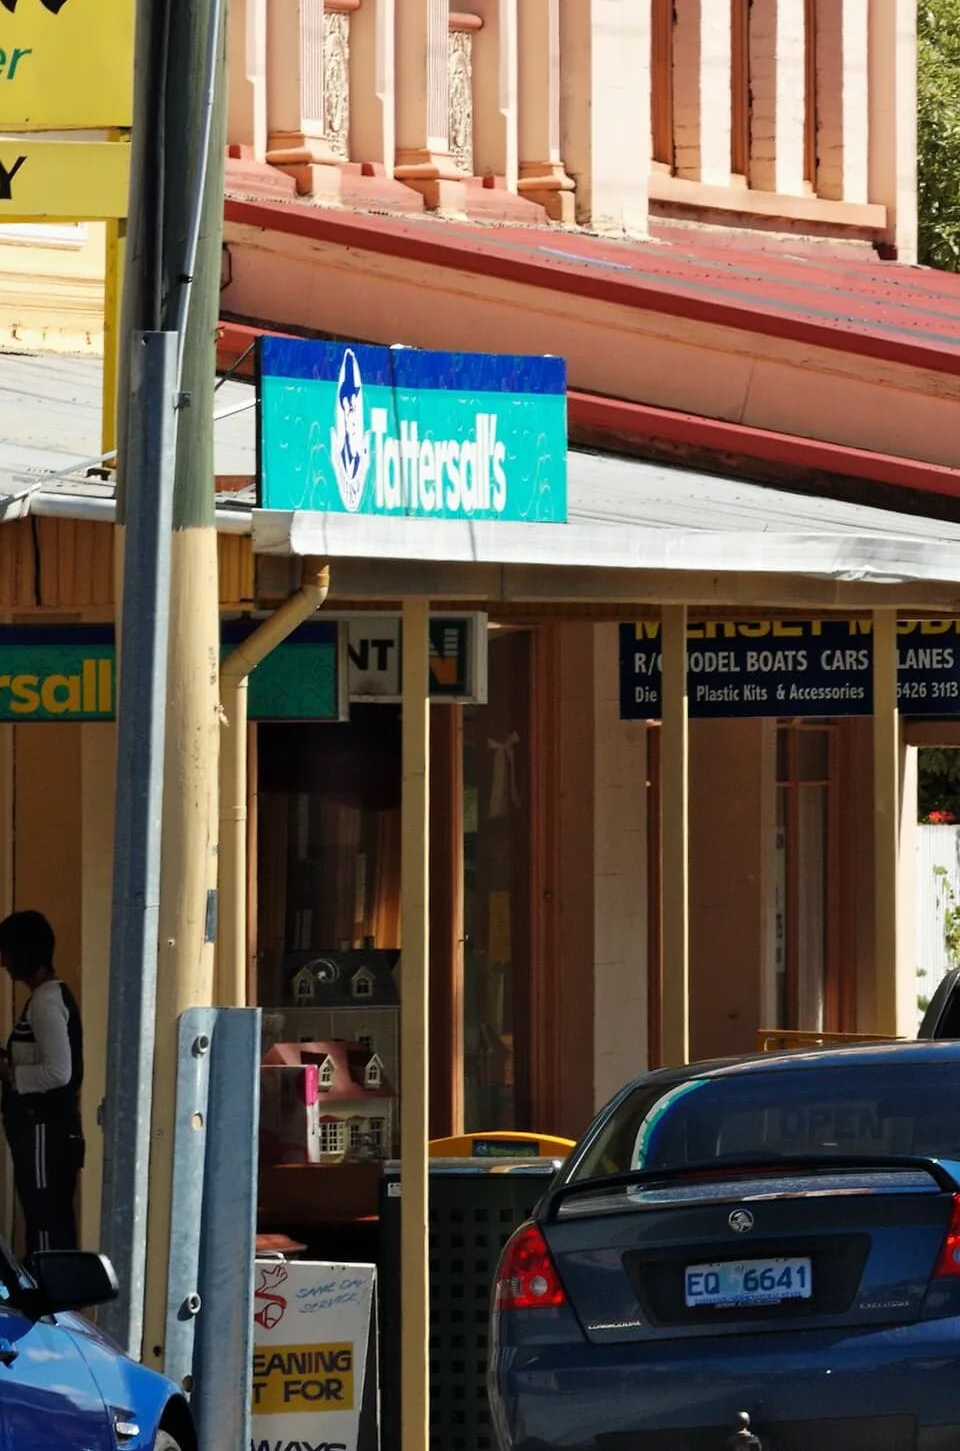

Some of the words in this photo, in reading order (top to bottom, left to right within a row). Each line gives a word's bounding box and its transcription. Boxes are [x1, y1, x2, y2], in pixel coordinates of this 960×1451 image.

[686, 650, 740, 673] ODEL
[746, 650, 808, 672] BOATS
[820, 648, 869, 671] CARS
[635, 685, 657, 702] Die
[696, 683, 739, 702] Plastic
[743, 682, 768, 701] Kits
[776, 683, 786, 700] &
[789, 681, 865, 700] Accessories
[931, 681, 958, 697] 3113
[296, 1281, 336, 1299] SAME
[688, 1272, 720, 1296] EQ
[744, 1265, 806, 1292] 6641
[284, 1379, 344, 1402] FOR
